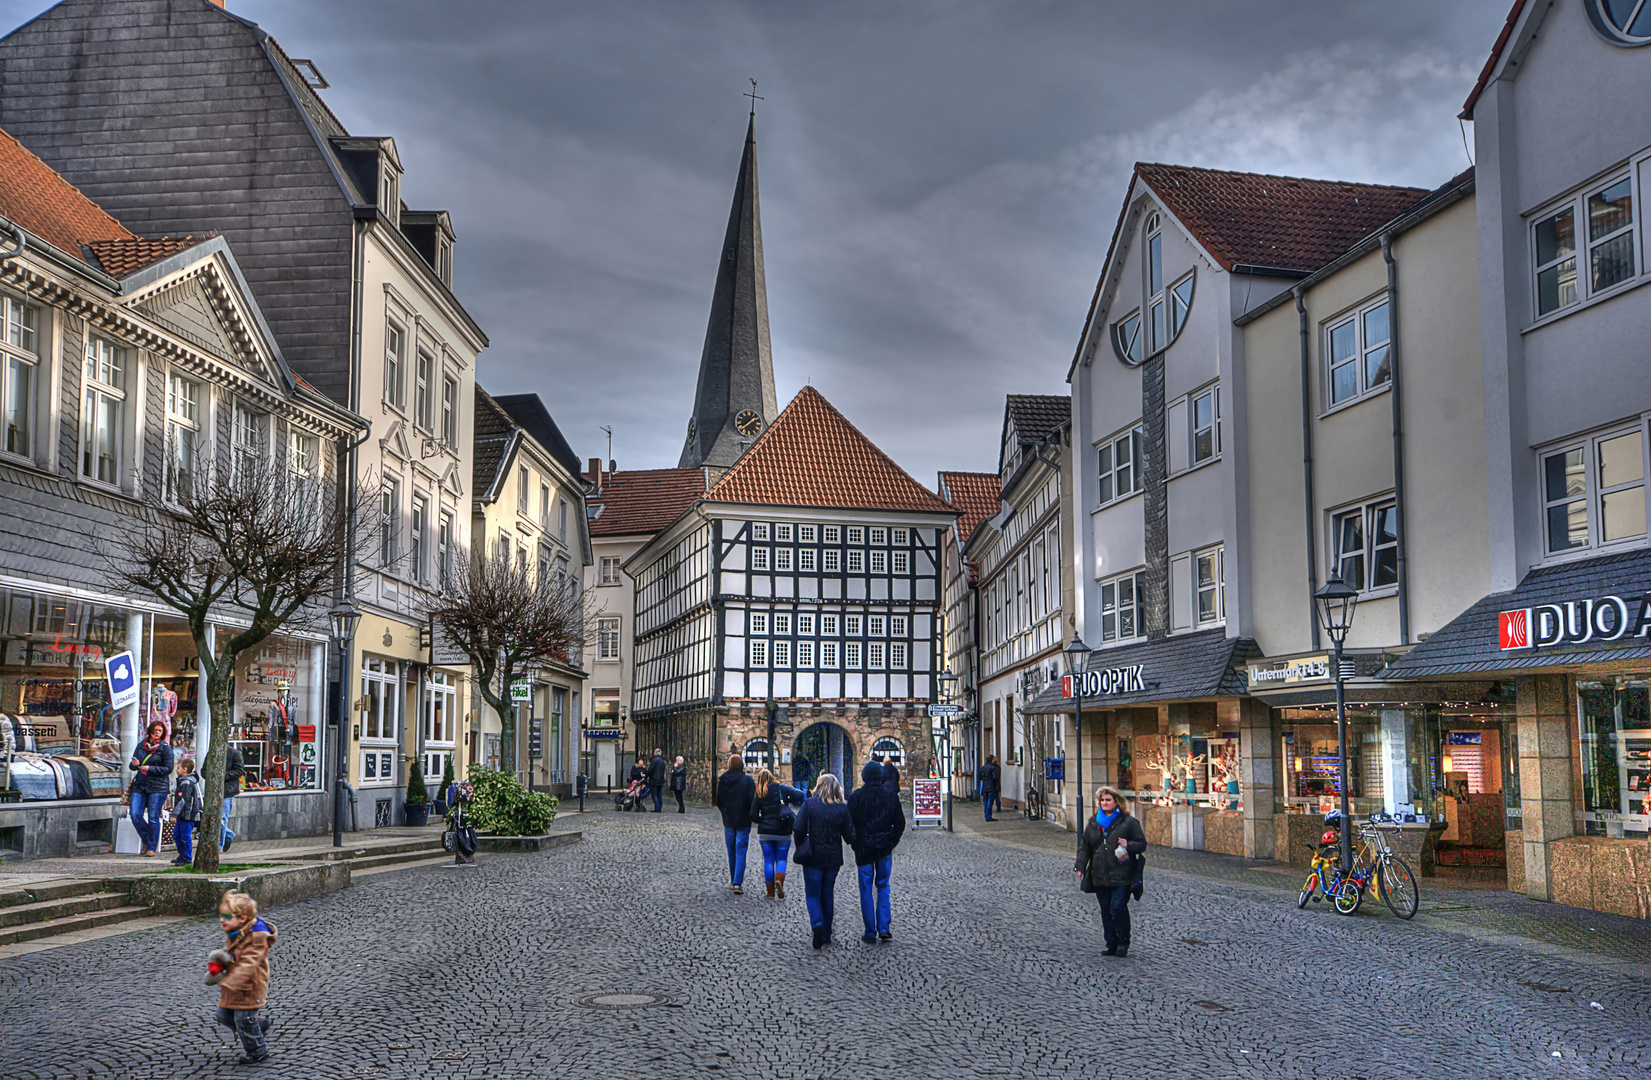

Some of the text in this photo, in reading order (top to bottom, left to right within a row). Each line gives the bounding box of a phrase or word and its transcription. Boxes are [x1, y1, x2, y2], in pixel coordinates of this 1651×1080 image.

[1534, 596, 1628, 647] DUO
[50, 631, 102, 663] Luxury
[265, 662, 297, 683] Luxury
[1251, 661, 1325, 681] Untermarkt 4-8
[114, 692, 137, 706] LEONARDO
[15, 723, 57, 737] bassetti
